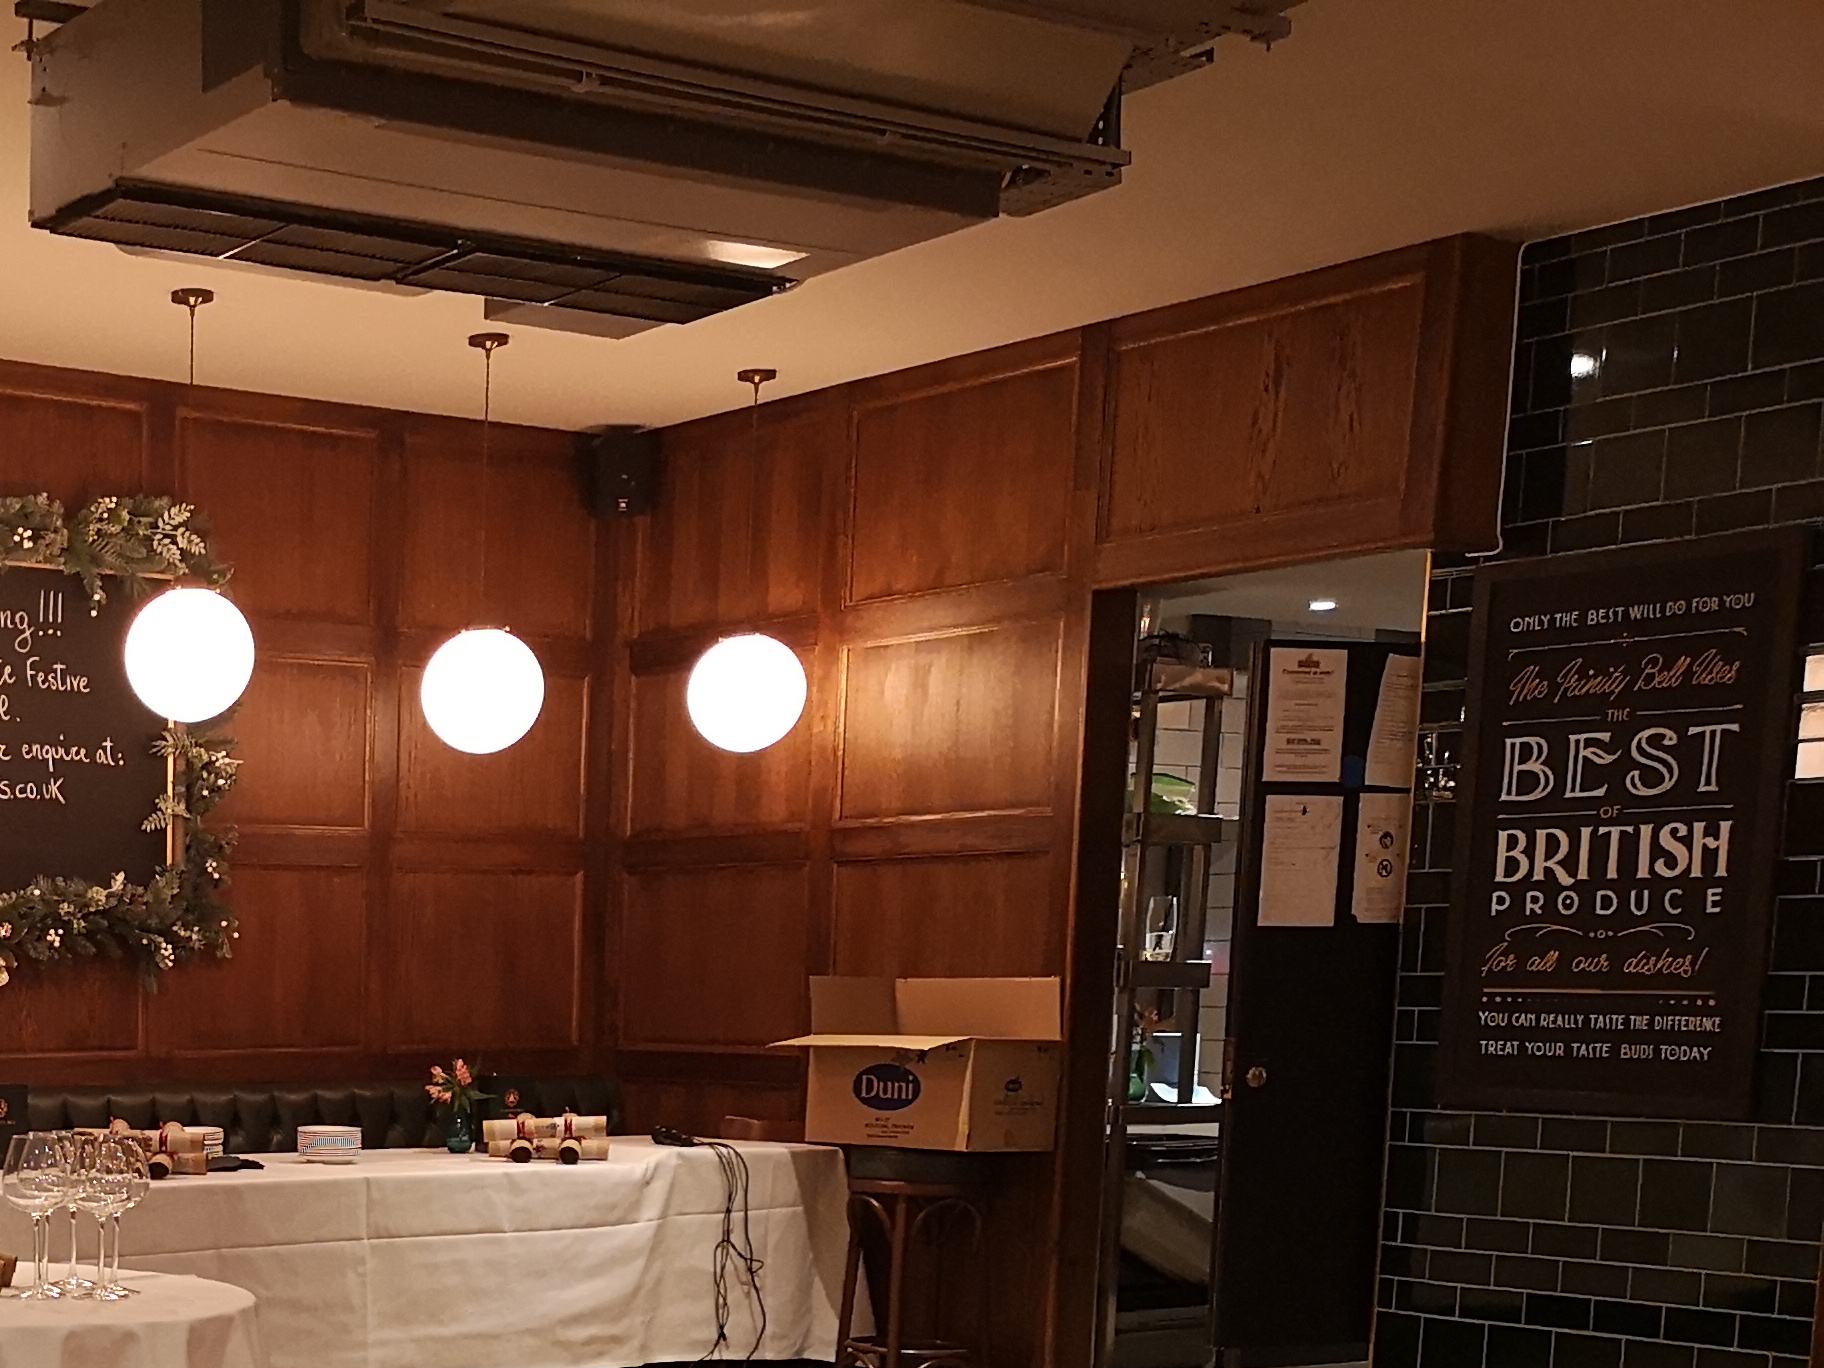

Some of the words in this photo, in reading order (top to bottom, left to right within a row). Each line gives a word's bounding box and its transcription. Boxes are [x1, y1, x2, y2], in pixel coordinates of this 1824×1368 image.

[1509, 614, 1550, 633] ONLY
[1554, 610, 1579, 628] THE
[1587, 606, 1625, 626] BEST
[1629, 602, 1662, 620] WILL
[1665, 600, 1686, 616] DO
[1691, 596, 1719, 613] FOR
[1723, 592, 1755, 609] YOU
[26, 656, 91, 693] Festive
[1509, 665, 1548, 706] The
[1553, 657, 1630, 703] Trinity
[1633, 653, 1691, 691] Bell
[1691, 648, 1741, 686] Uses
[1605, 708, 1630, 722] THE
[21, 733, 90, 773] enquire
[96, 736, 124, 766] at:
[1499, 723, 1740, 801] BEST
[1599, 805, 1622, 819] OF
[1493, 820, 1734, 887] BRITISH
[1490, 887, 1724, 917] PRODUCE
[1526, 950, 1560, 972] all
[1571, 953, 1611, 973] our
[1623, 947, 1709, 978] dishes!
[1478, 1010, 1508, 1027] YOU
[1511, 1012, 1536, 1027] CAN
[1539, 1013, 1585, 1029] REALLY
[1589, 1014, 1625, 1030] TASTE
[1629, 1015, 1649, 1030] THE
[1479, 1040, 1519, 1056] TREAT
[1525, 1041, 1564, 1057] YOUR
[1571, 1042, 1612, 1058] TASTE
[1620, 1044, 1654, 1059] BUDS
[1659, 1045, 1713, 1062] TODAY
[860, 1074, 914, 1100] Duni
